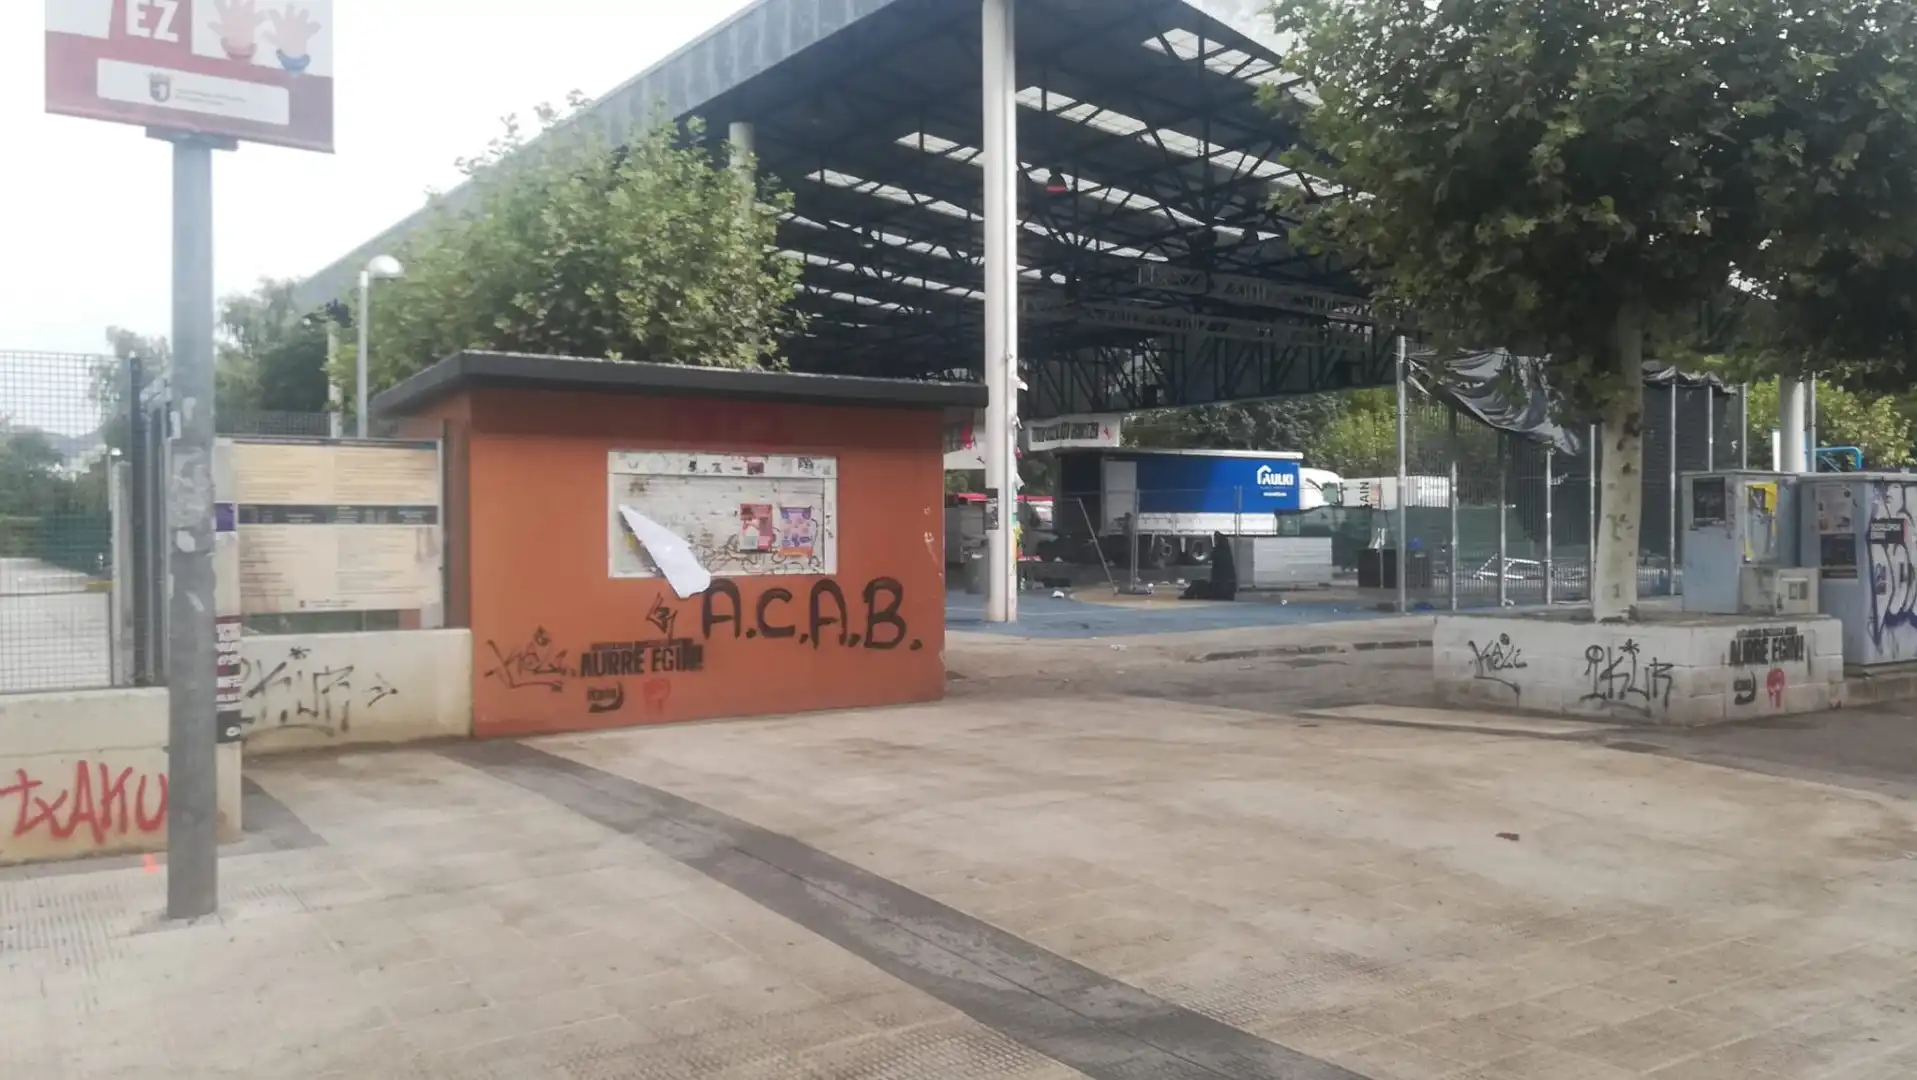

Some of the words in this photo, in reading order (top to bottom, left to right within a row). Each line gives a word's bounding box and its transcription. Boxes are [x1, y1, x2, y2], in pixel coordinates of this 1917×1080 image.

[126, 0, 179, 43] EZ
[1360, 481, 1370, 508] AIN
[701, 577, 923, 651] A.C.A.B.
